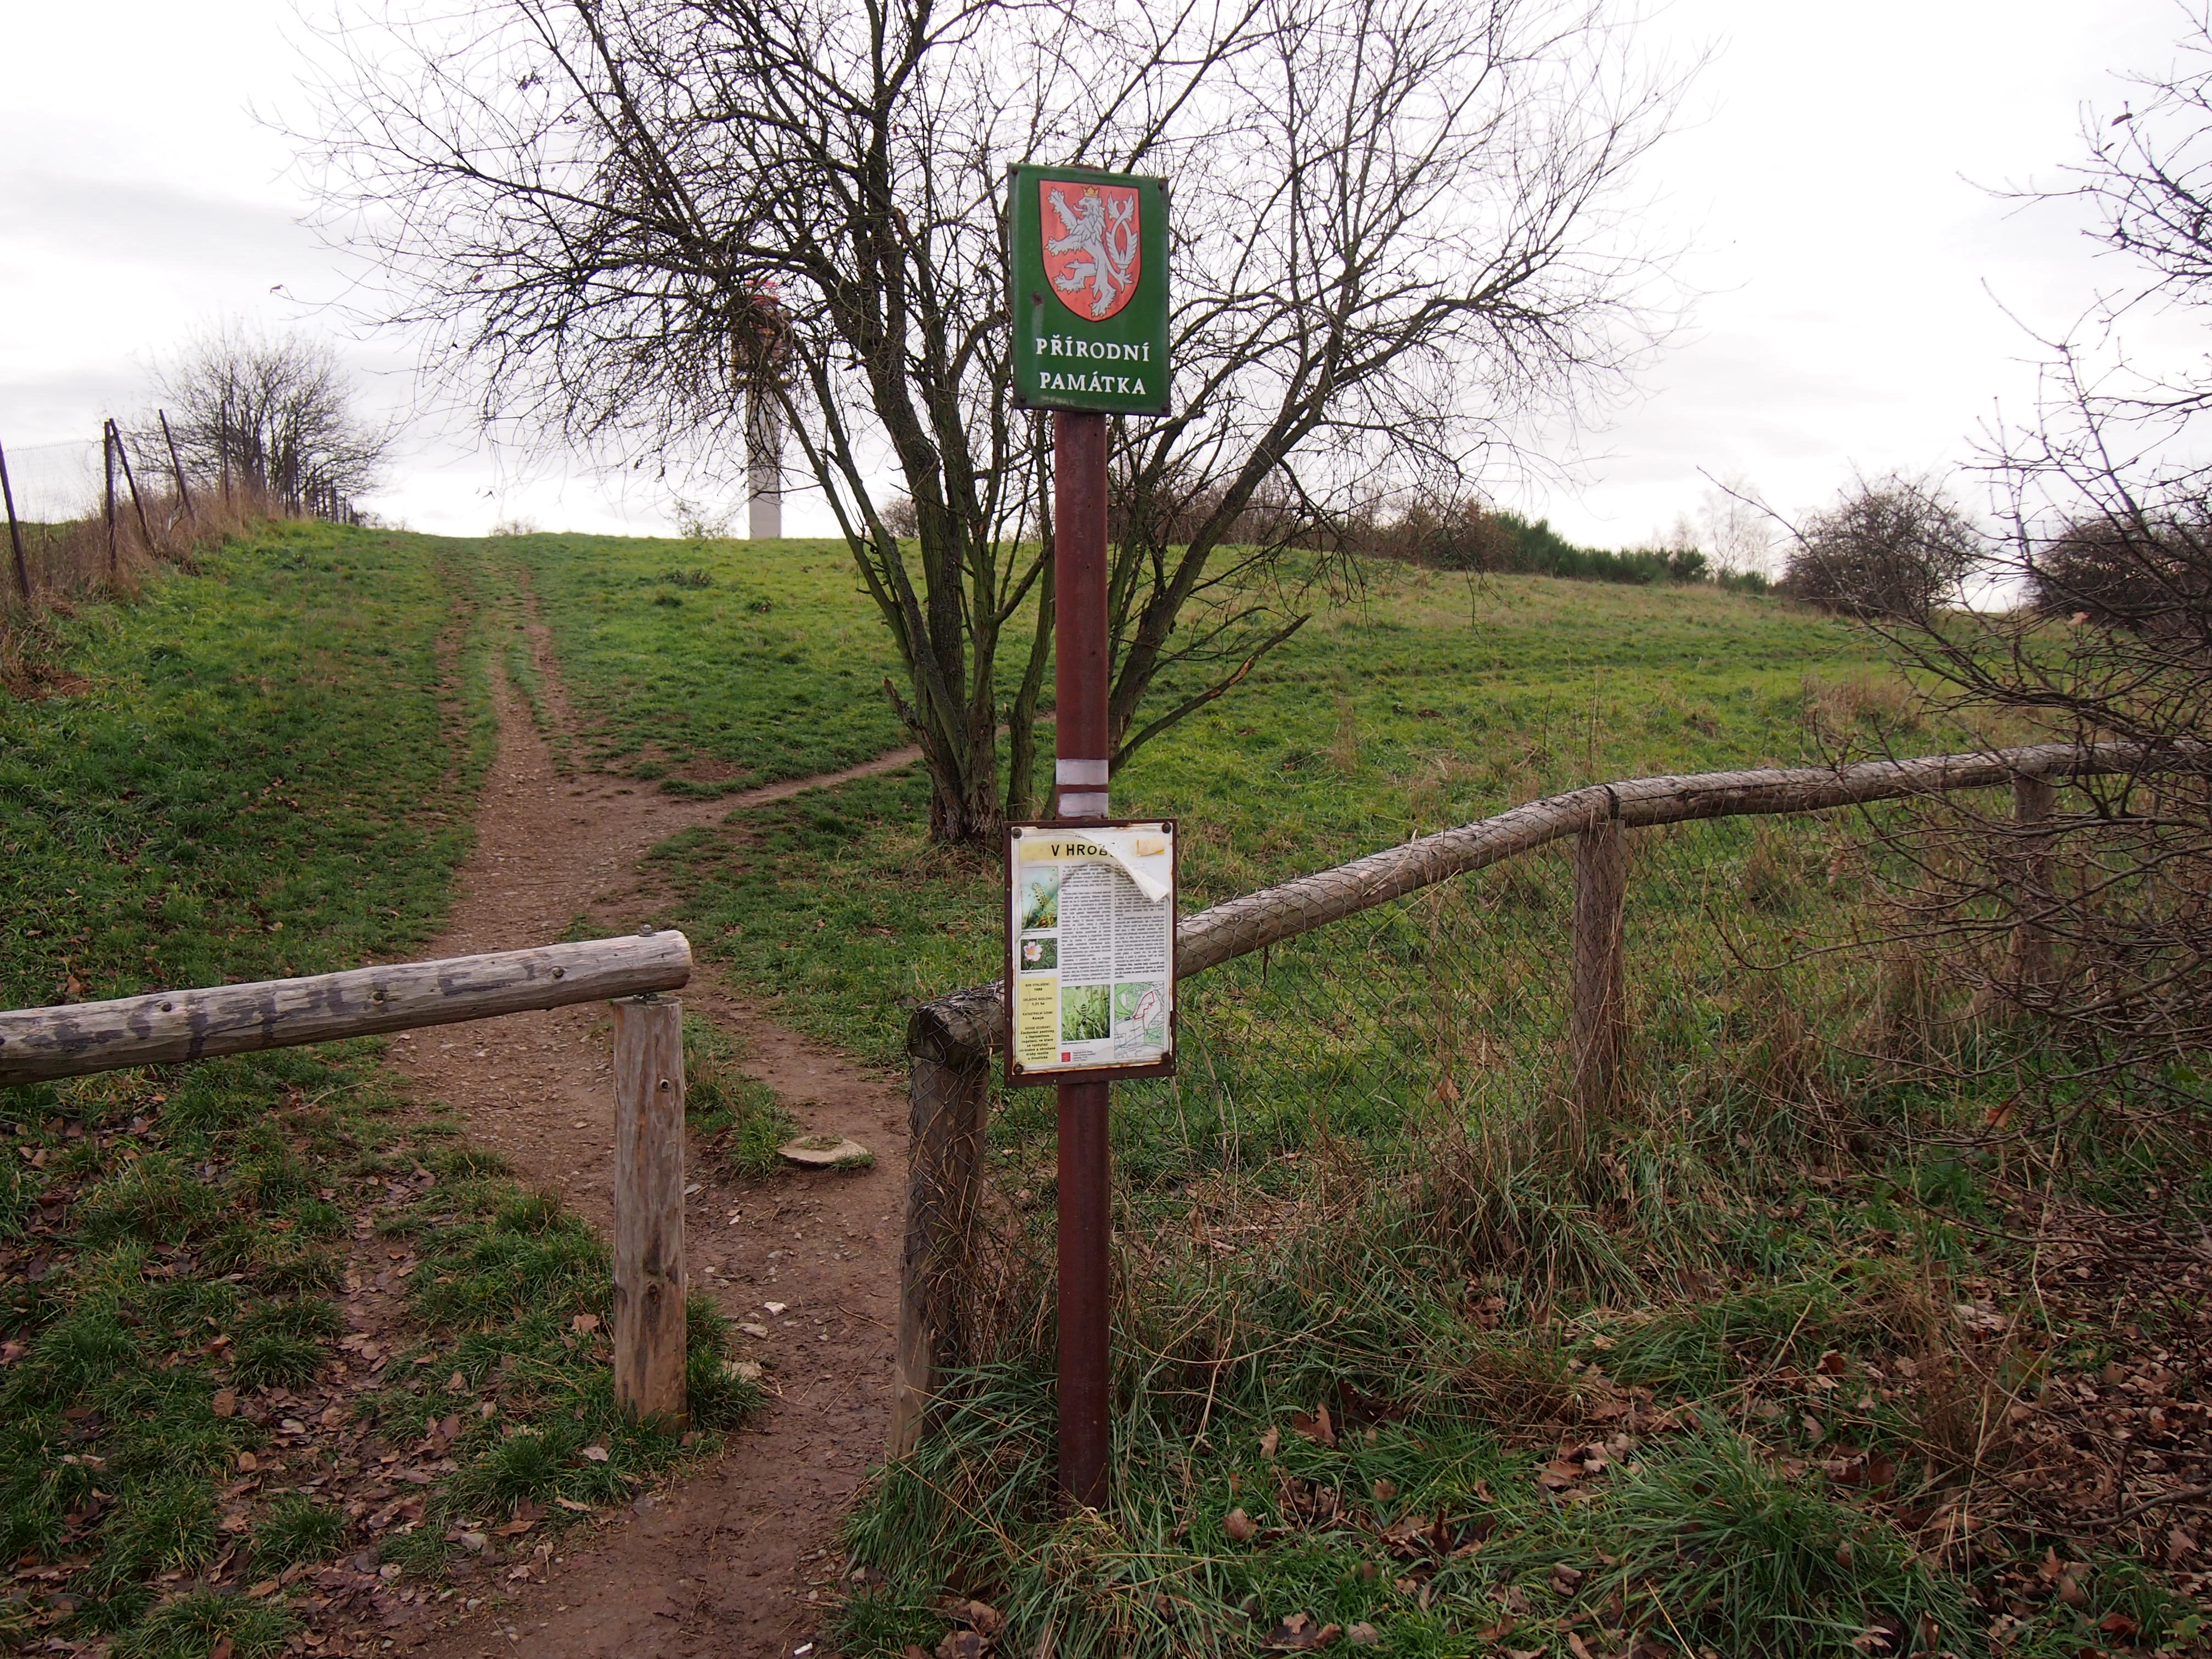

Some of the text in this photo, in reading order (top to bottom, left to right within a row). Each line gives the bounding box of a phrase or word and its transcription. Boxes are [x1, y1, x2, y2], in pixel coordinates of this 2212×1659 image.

[1036, 334, 1150, 362] PŘÍRODNÍ
[1039, 370, 1147, 395] PAMÁTKA
[1051, 844, 1059, 856] V
